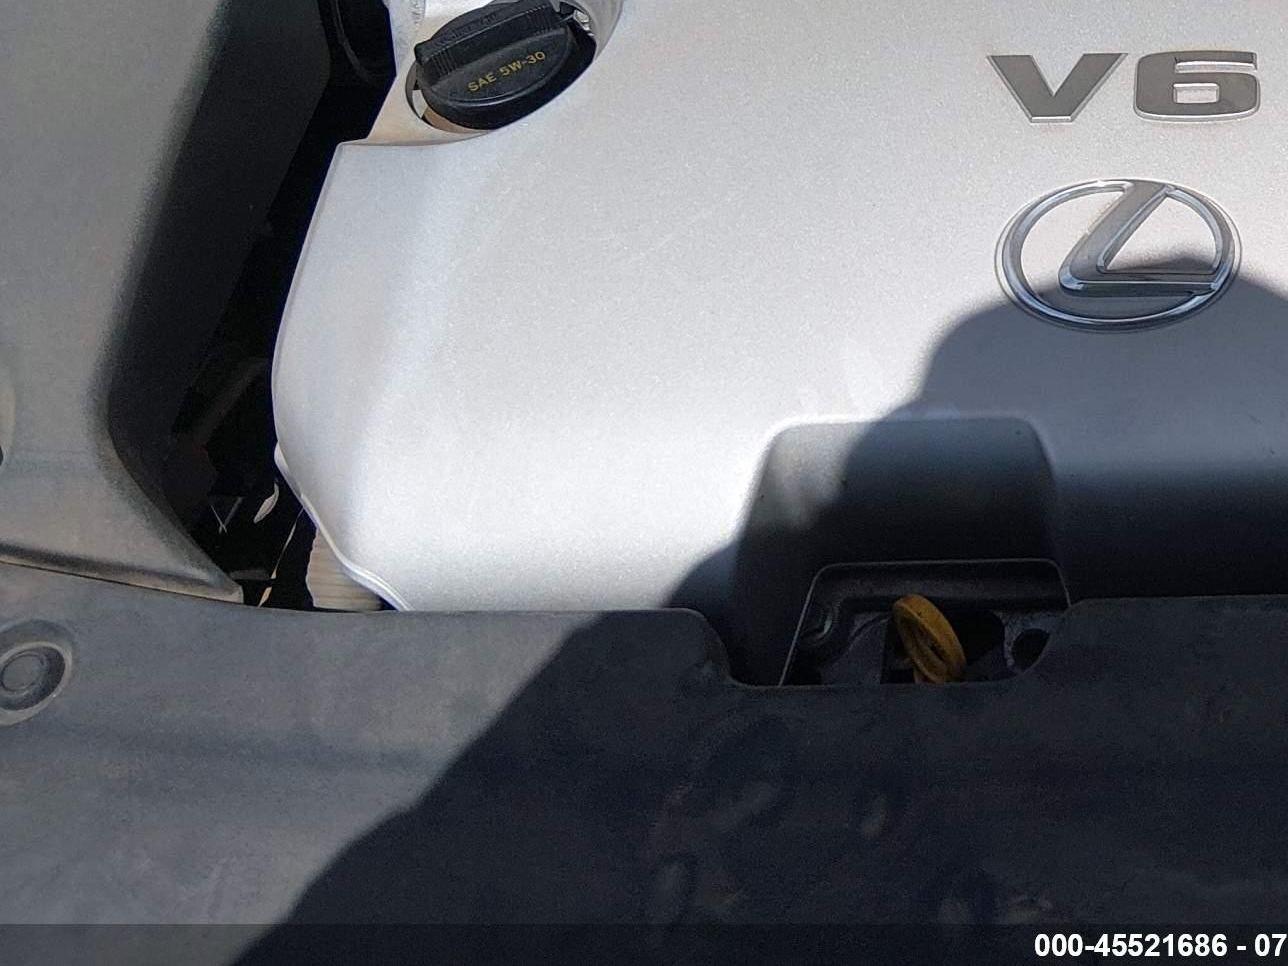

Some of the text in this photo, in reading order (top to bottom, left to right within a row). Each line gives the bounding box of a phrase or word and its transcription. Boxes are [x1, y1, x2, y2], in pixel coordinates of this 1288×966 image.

[468, 51, 546, 92] SAE 5W-30
[987, 50, 1261, 122] V6
